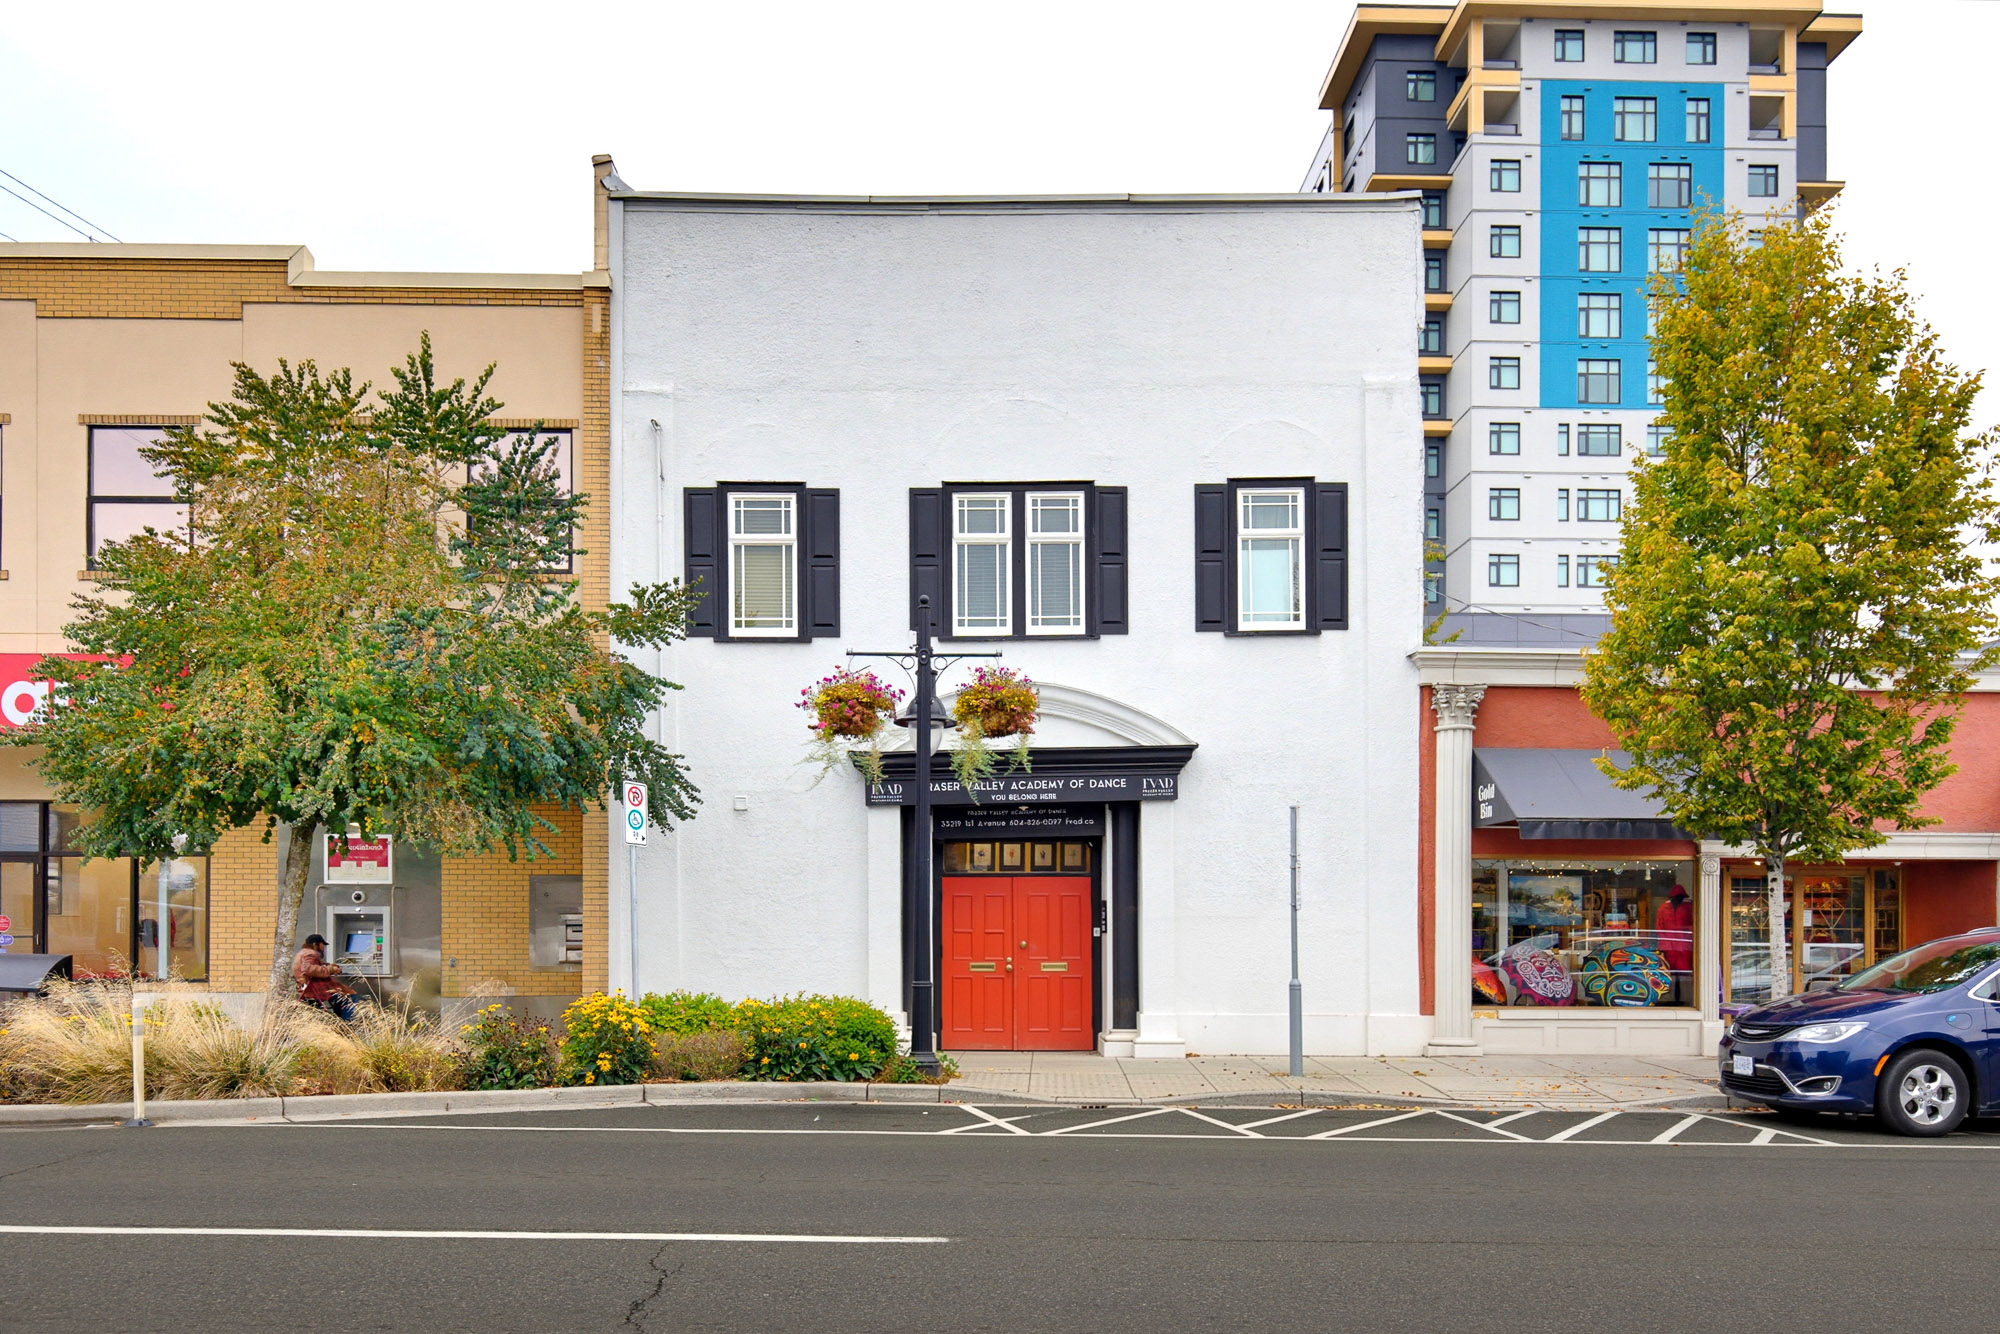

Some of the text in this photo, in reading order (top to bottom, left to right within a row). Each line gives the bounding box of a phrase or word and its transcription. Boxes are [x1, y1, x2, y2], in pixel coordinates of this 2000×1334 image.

[1010, 779, 1065, 790] ACADEMY
[1069, 779, 1085, 789] OF
[1089, 778, 1127, 788] DANCE
[1008, 793, 1037, 801] BELONG
[1478, 783, 1495, 801] Gold
[1480, 802, 1493, 819] Bin
